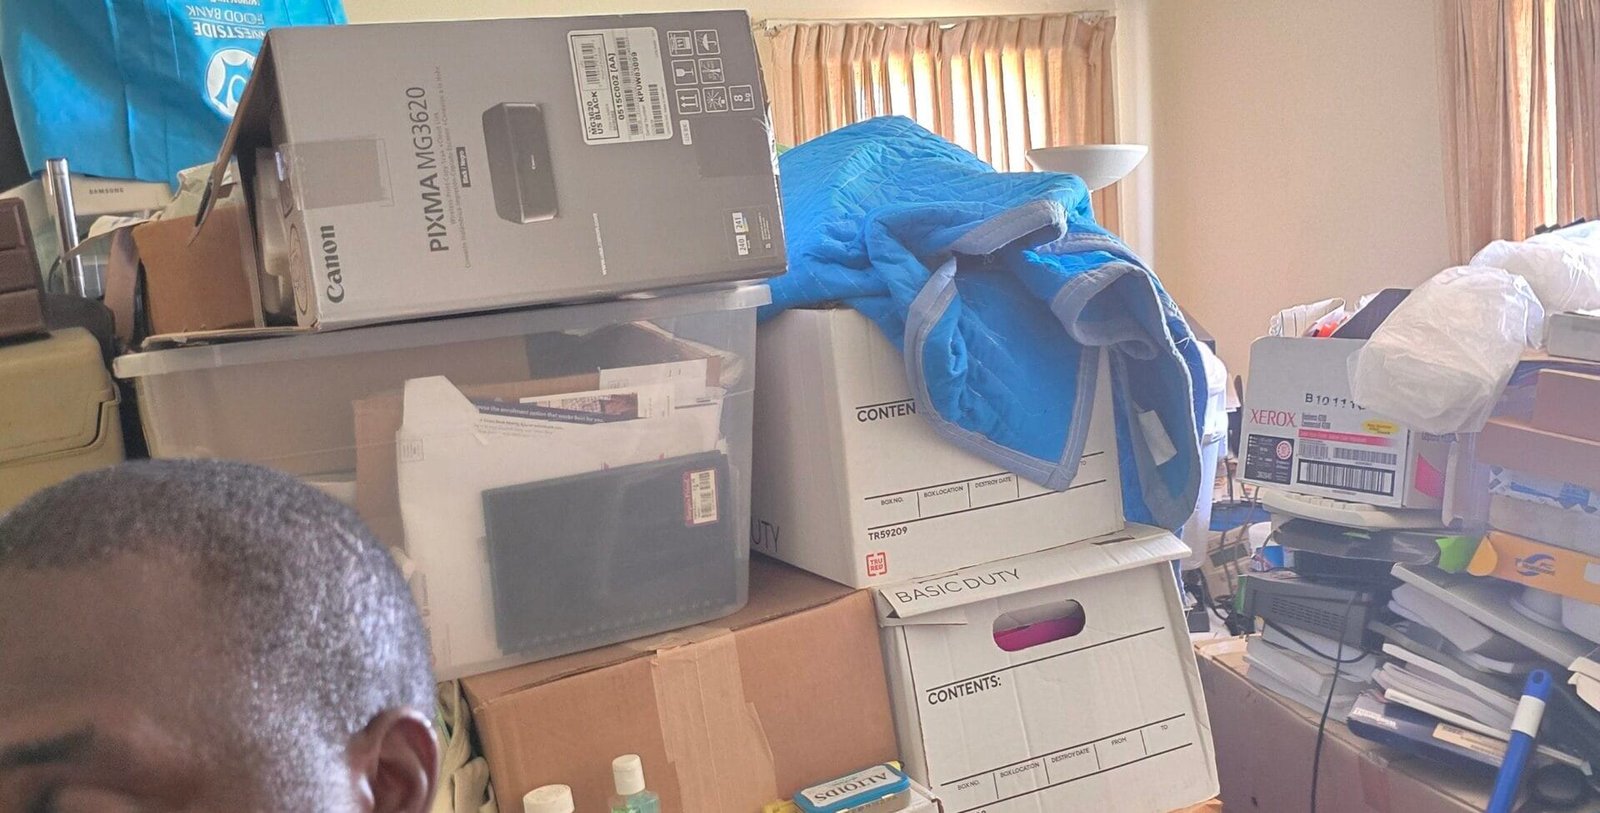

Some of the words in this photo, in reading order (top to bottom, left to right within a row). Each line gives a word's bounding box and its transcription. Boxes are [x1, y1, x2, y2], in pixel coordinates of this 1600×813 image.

[186, 5, 221, 20] BANK
[224, 9, 265, 25] FOOD
[608, 53, 618, 73] [AA]
[612, 75, 625, 121] 0515C002
[733, 94, 743, 102] 8
[744, 92, 751, 102] kg
[591, 91, 602, 120] BLACK
[405, 86, 437, 170] MG3620
[596, 122, 604, 135] US
[89, 187, 125, 195] SAMSUNG
[420, 172, 449, 252] PIXMA
[738, 238, 747, 254] 240
[320, 225, 344, 303] Canon
[857, 402, 917, 422] CONTEN
[1250, 408, 1297, 427] XEROX
[975, 480, 998, 489] DESTROY
[999, 476, 1012, 484] DATE
[924, 490, 936, 498] BOX
[936, 485, 964, 496] LOCATION
[751, 516, 780, 553] UTY
[868, 526, 908, 541] TR59209
[895, 581, 962, 603] BASIC
[963, 568, 1020, 589] DUTY
[928, 675, 1002, 705] CONTENTS:
[1111, 737, 1127, 746] FROM
[1051, 753, 1075, 763] DESTROY
[1075, 748, 1090, 758] DATE
[1000, 770, 1012, 778] BOX
[1012, 762, 1040, 776] LOCATION
[815, 772, 888, 800] ALTOIDS
[957, 782, 970, 791] BOX
